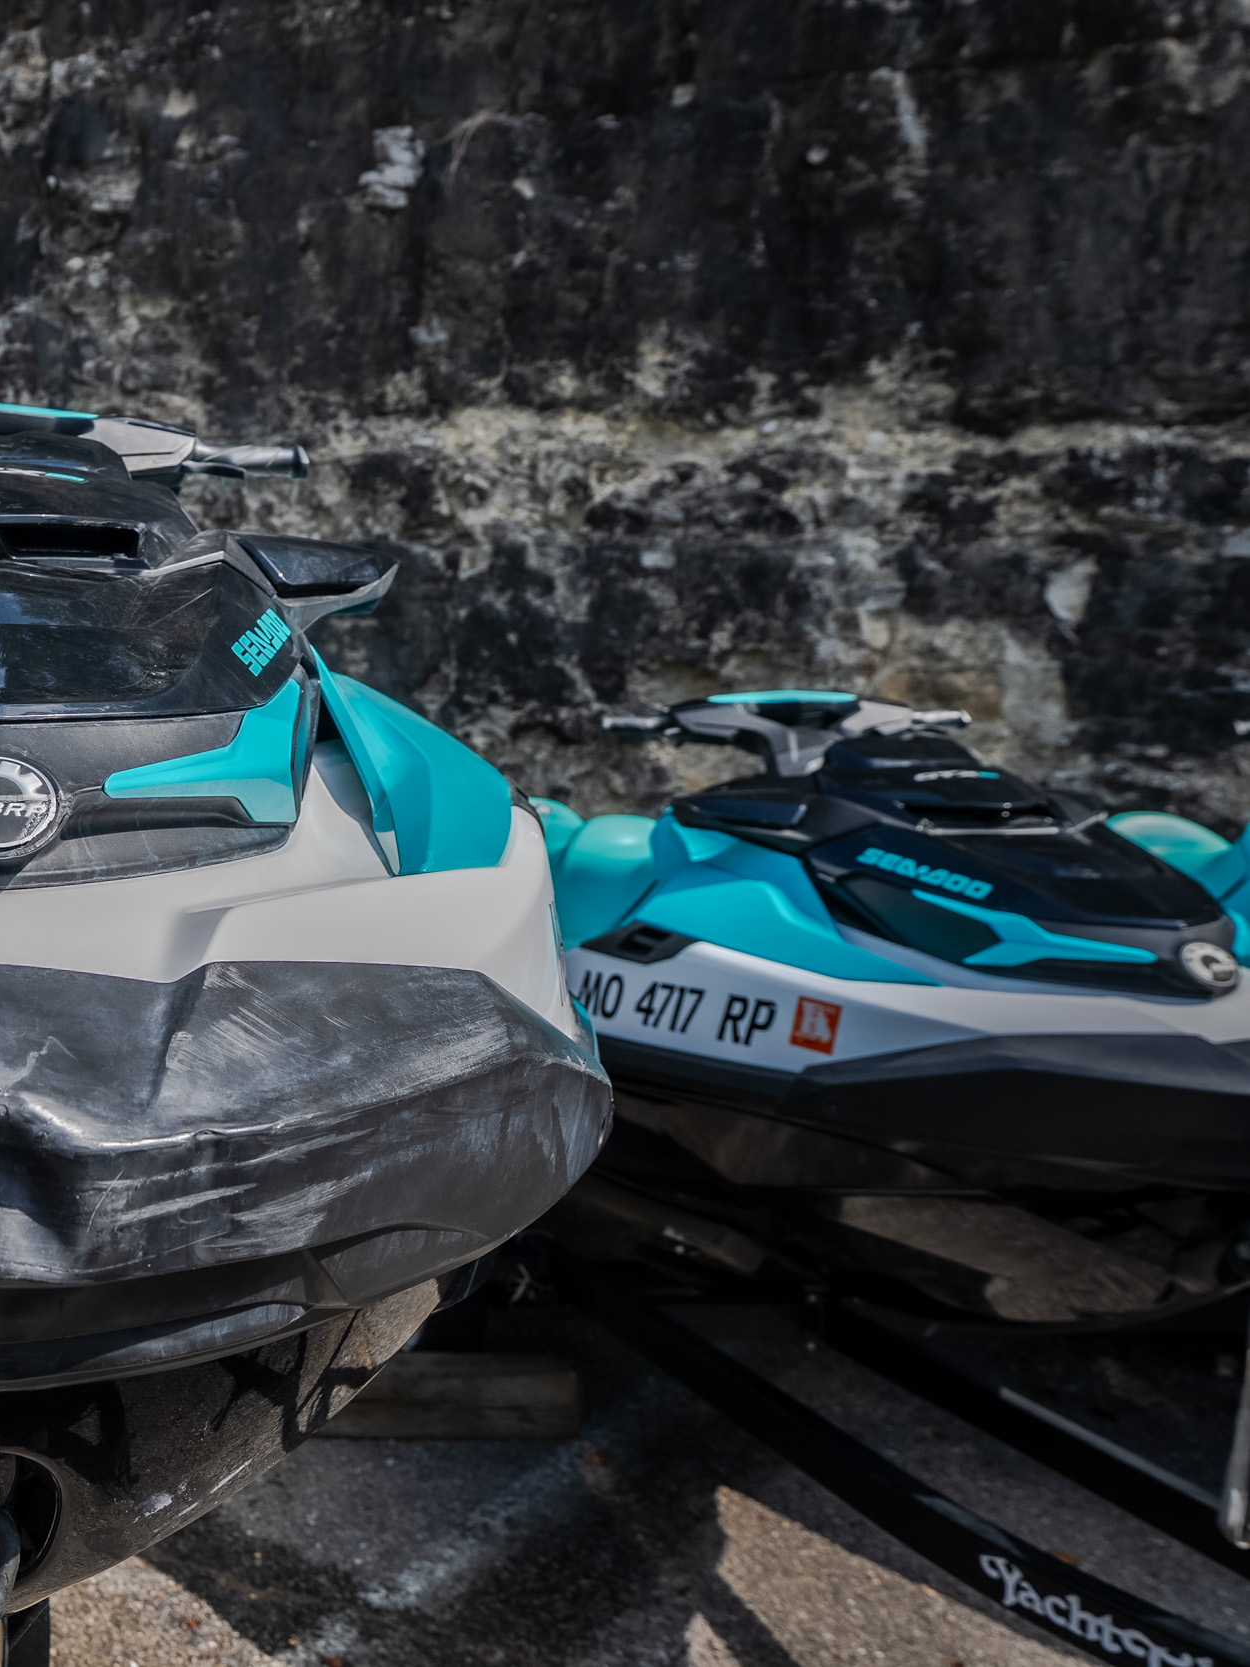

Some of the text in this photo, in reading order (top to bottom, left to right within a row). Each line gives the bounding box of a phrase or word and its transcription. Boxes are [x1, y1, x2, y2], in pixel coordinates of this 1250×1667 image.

[580, 969, 624, 1020] MO
[635, 980, 706, 1034] 4717
[715, 993, 778, 1047] RP
